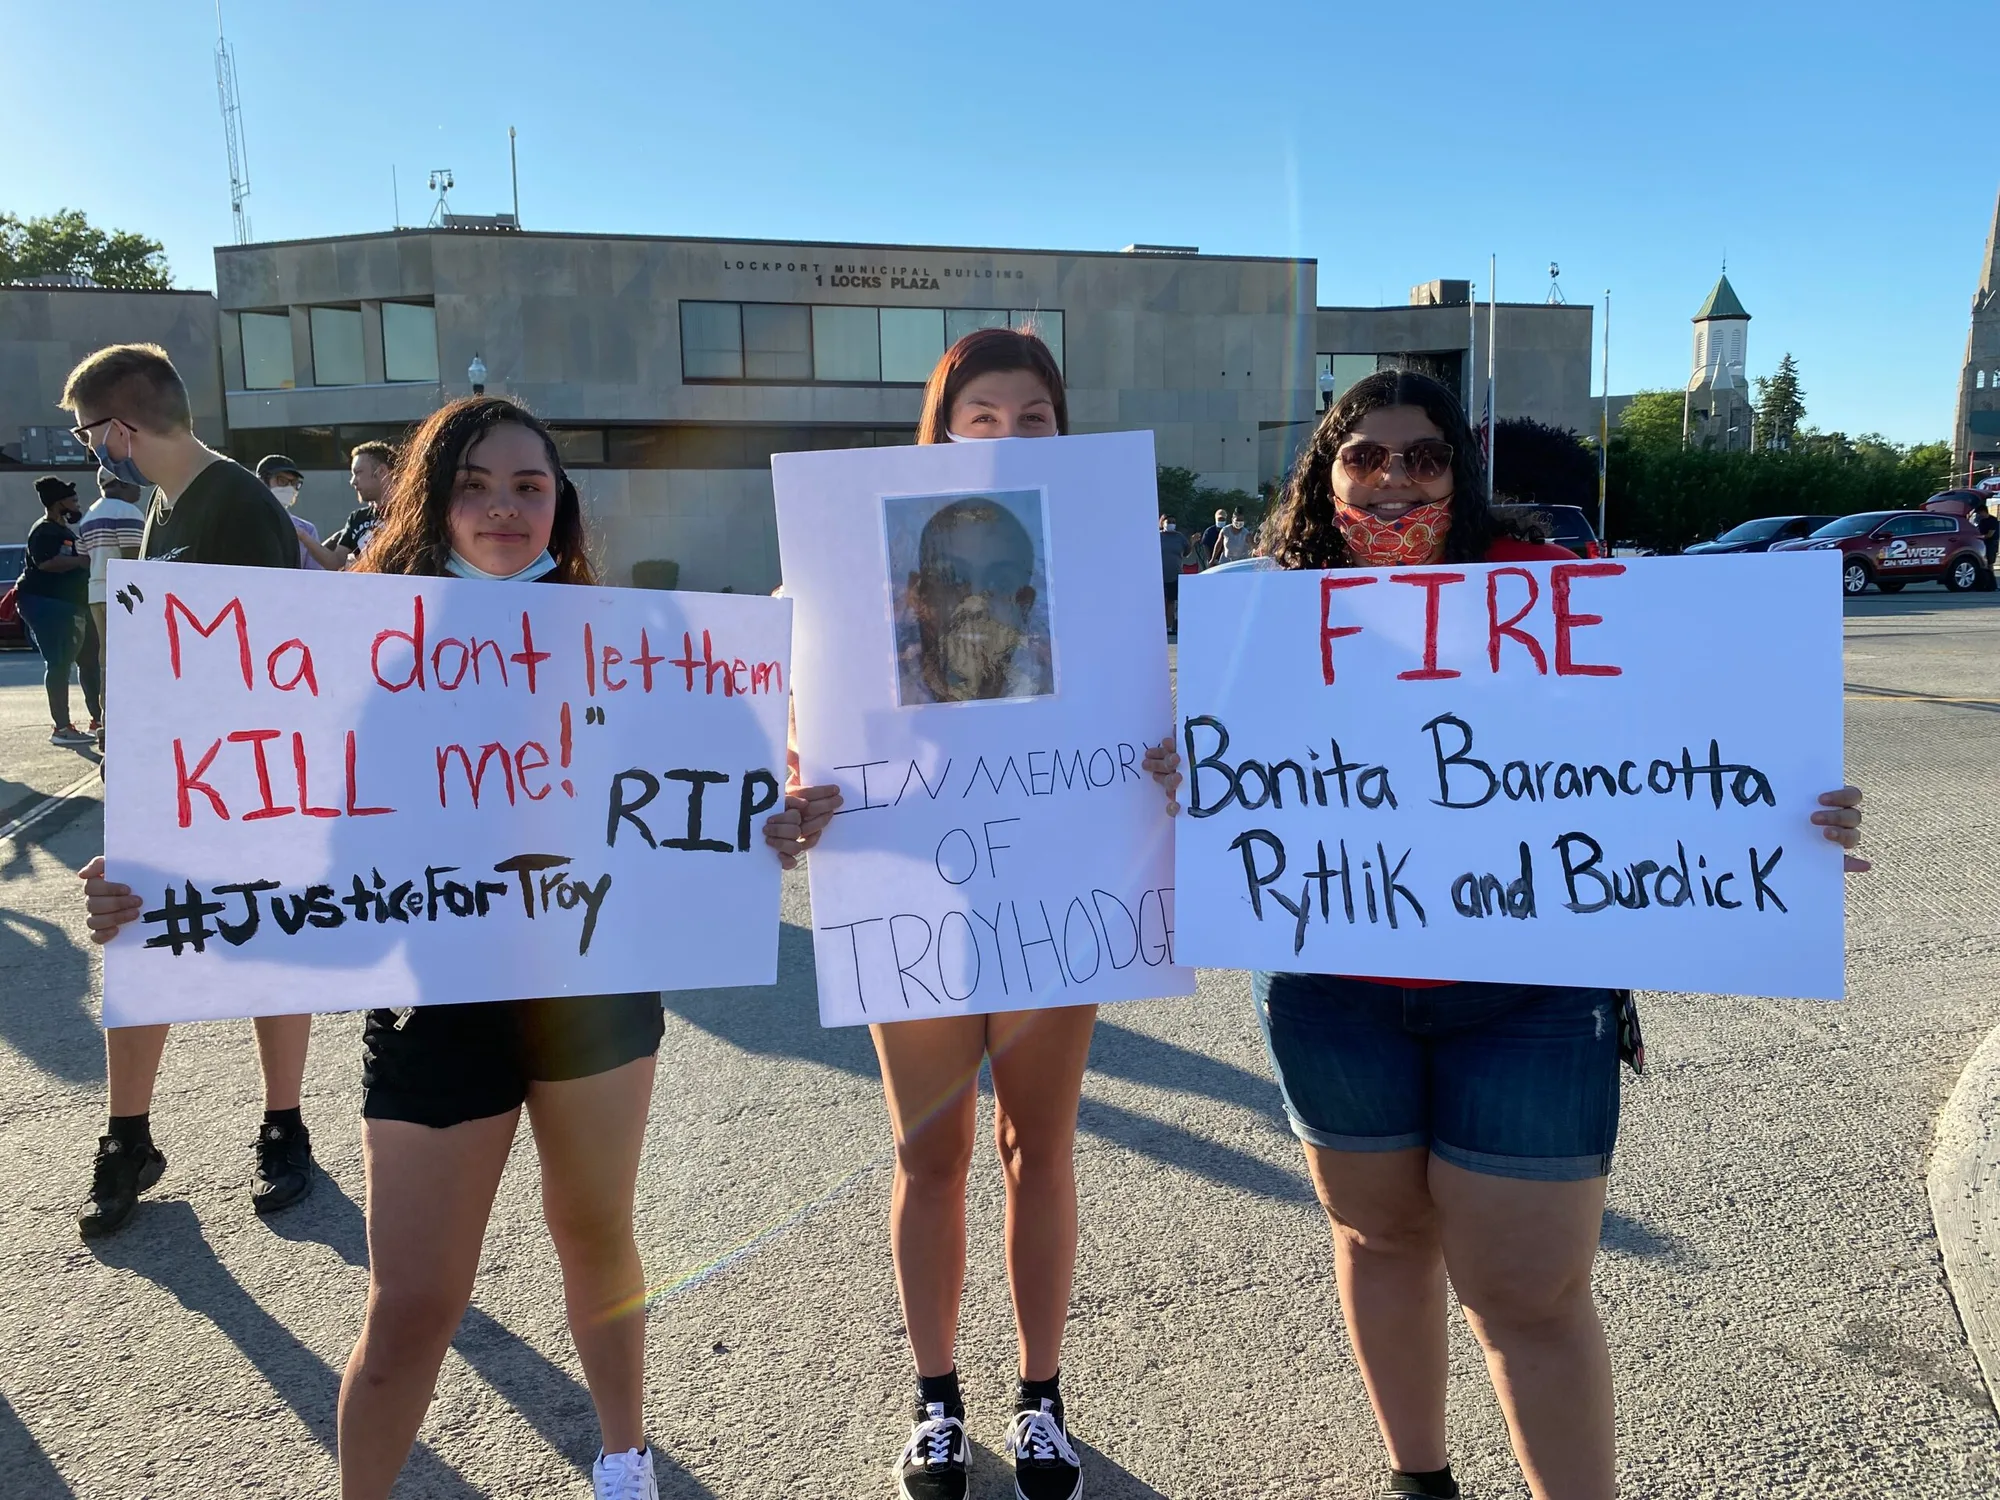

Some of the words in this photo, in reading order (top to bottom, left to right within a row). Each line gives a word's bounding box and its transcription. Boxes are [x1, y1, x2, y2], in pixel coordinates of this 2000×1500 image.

[724, 260, 820, 273] LOCKPORT
[834, 264, 930, 276] MUNICIPAL
[943, 268, 1024, 280] BUILDING
[815, 275, 823, 287] 1
[831, 275, 882, 288] LOCKS
[890, 277, 940, 290] PLAZA
[1890, 540, 1907, 558] 2
[1907, 547, 1946, 558] WGRZ
[370, 594, 552, 694] dont
[1320, 564, 1627, 685] FIRE
[172, 729, 398, 828] KILL
[963, 742, 1161, 799] MEMOR
[1184, 714, 1399, 819] Bonita
[1421, 711, 1776, 810] Barancotta
[606, 768, 779, 853] RIP
[935, 818, 1021, 885] OF
[1450, 841, 1538, 919] and
